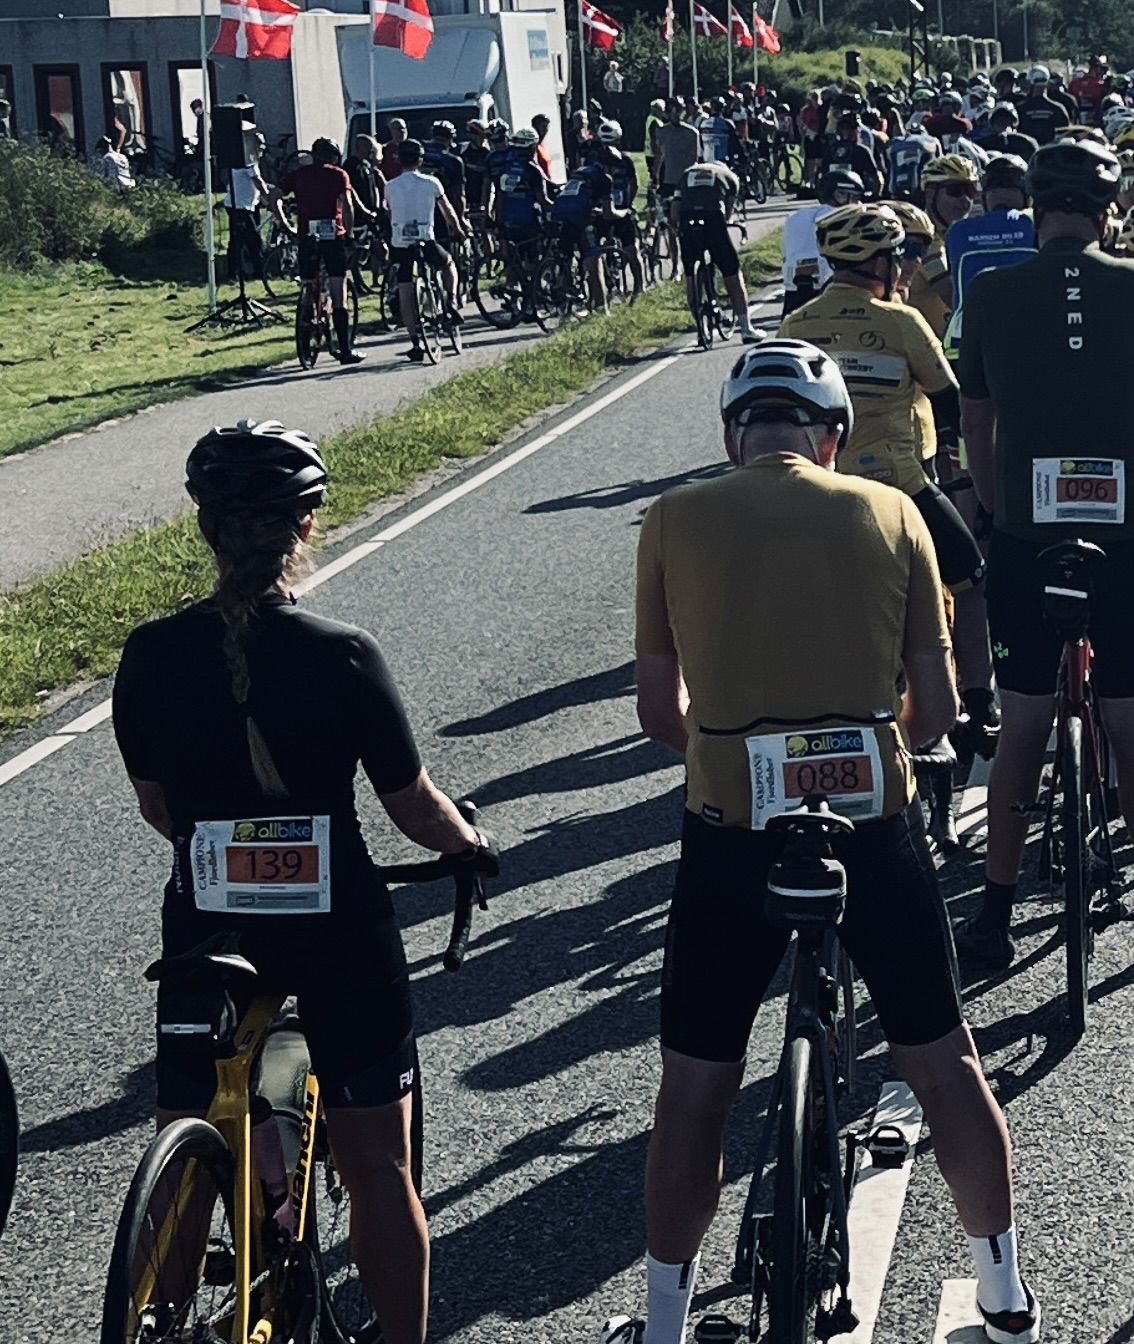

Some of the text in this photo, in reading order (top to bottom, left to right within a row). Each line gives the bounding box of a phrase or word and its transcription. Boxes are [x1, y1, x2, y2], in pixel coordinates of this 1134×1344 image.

[1066, 480, 1108, 500] 096
[811, 732, 862, 751] allbike
[754, 753, 765, 810] CAMPIONE
[797, 761, 859, 792] 088
[258, 822, 312, 838] allbike
[196, 833, 207, 890] CAMPIONE
[247, 849, 303, 879] 139
